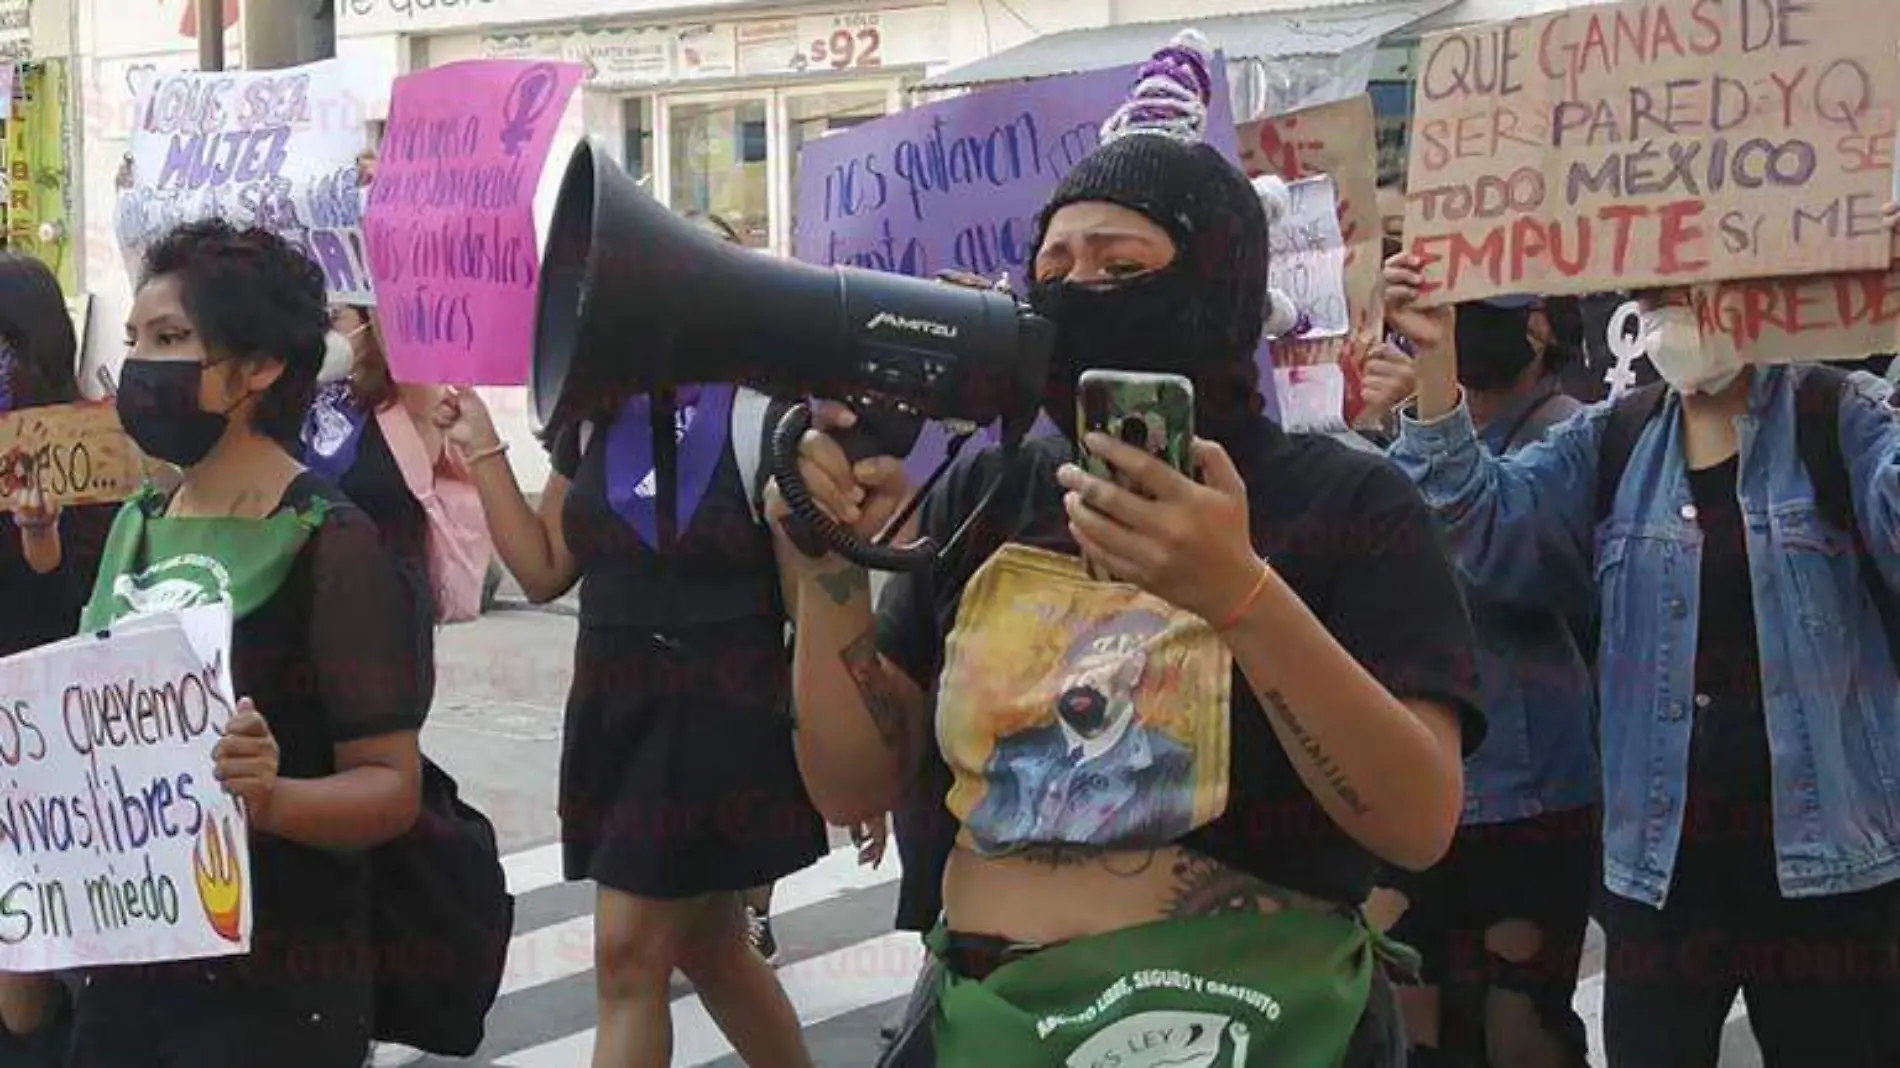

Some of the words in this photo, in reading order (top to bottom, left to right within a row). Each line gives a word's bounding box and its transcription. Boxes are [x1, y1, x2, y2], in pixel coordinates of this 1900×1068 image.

[1423, 19, 1524, 101] QUE
[1537, 1, 1721, 100] GANAS
[1740, 0, 1808, 53] DE
[157, 125, 291, 191] MUJER
[1420, 106, 1543, 171] SER
[1552, 67, 1749, 148] PARED
[1769, 66, 1808, 128] Y
[1813, 58, 1871, 131] Q
[824, 153, 887, 222] nos
[894, 111, 1041, 220] quitaron
[1405, 165, 1547, 222] TODO
[1565, 138, 1817, 206] MÉXICO
[1836, 127, 1895, 174] SE
[1409, 198, 1711, 299] EMPUTE
[1791, 190, 1883, 244] ME
[0, 700, 46, 768] os
[62, 652, 234, 770] queremos
[86, 764, 203, 854] libres
[0, 862, 72, 944] sin
[84, 852, 179, 931] miedo
[1131, 968, 1192, 991] SEGURO
[1192, 975, 1204, 993] Y
[1127, 1028, 1174, 1053] LEY
